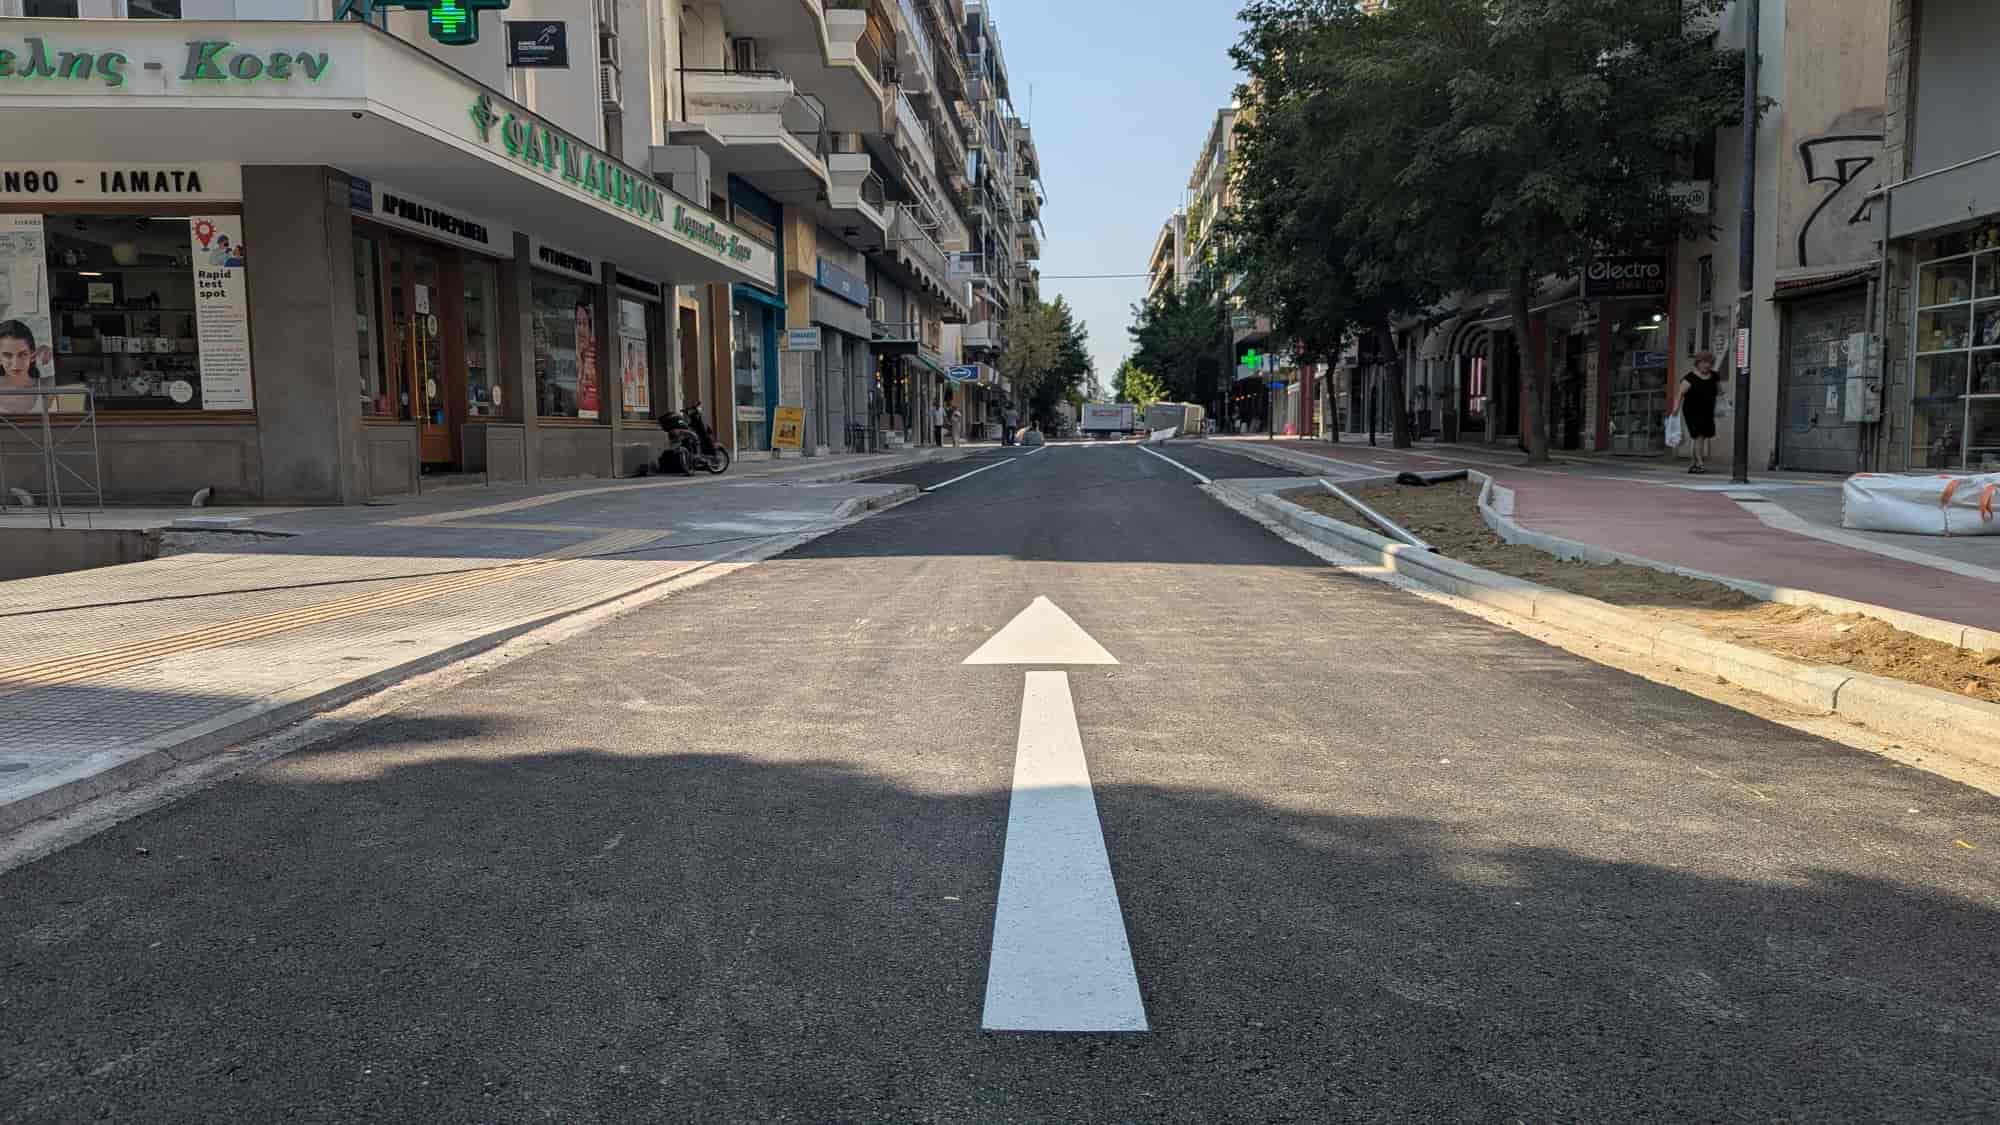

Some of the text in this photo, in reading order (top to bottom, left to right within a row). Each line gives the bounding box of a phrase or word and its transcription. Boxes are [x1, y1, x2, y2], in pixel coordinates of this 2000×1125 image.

[179, 39, 330, 81] Κοεν
[0, 170, 58, 193] ΝΘΟ
[100, 170, 203, 193] ΙΑΜΑΤΑ
[198, 269, 232, 280] Rapid
[1588, 260, 1661, 280] electro
[199, 280, 224, 288] test
[199, 290, 226, 300] spot
